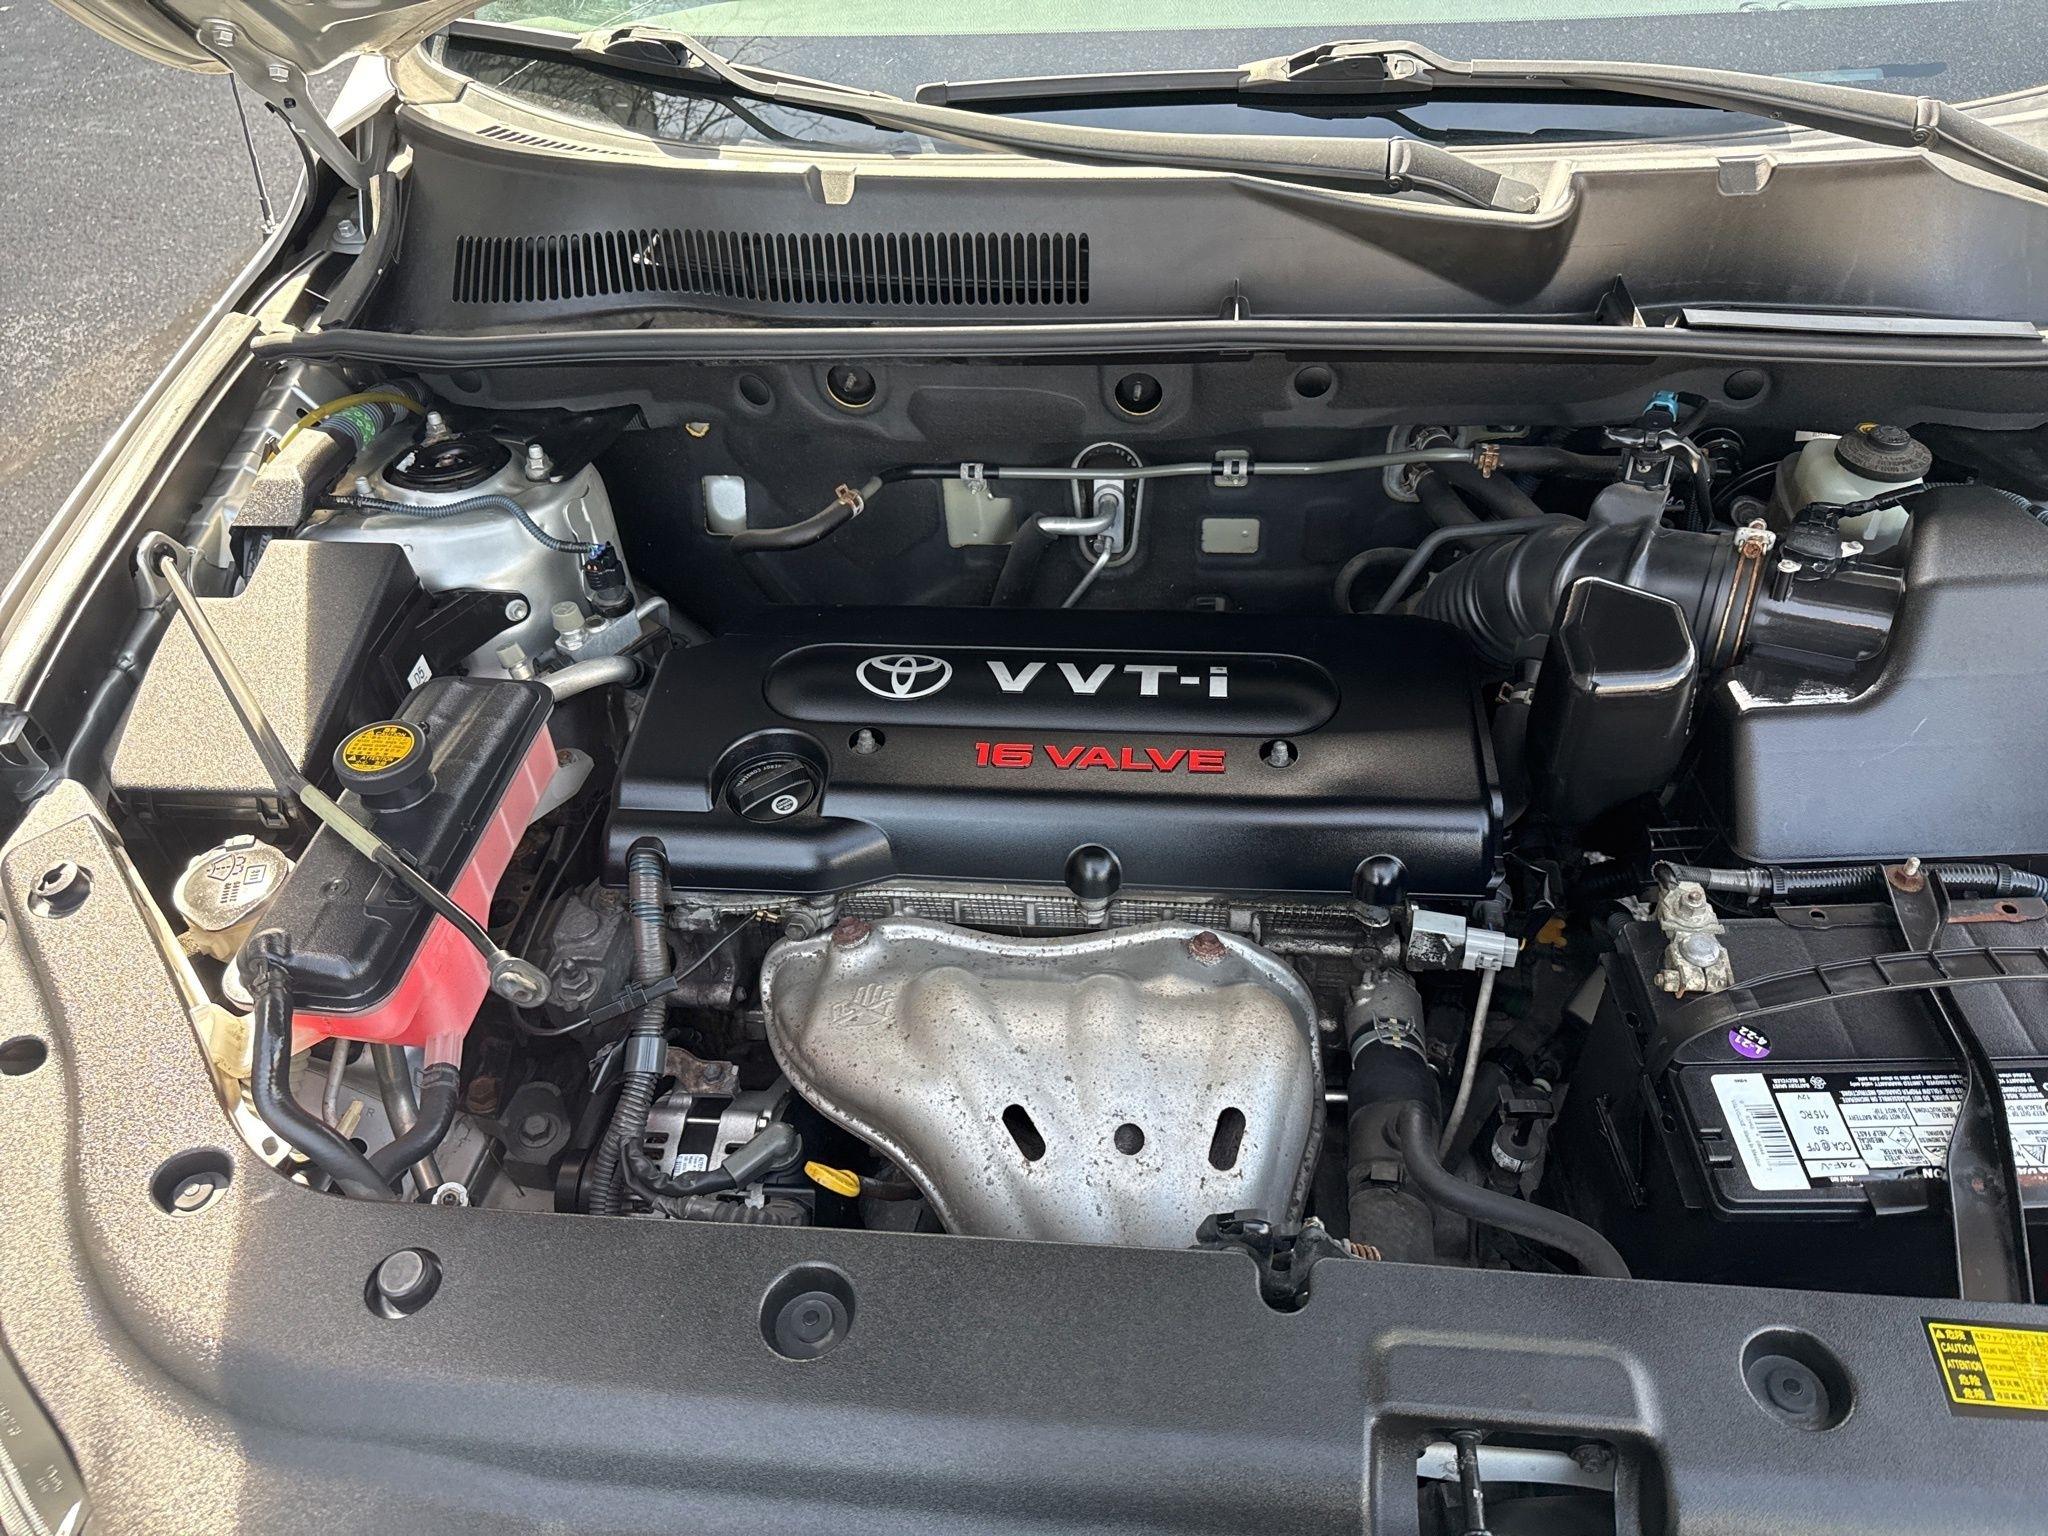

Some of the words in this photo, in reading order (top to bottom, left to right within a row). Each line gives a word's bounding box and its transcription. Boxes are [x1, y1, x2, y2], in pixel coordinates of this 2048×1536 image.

[986, 661, 1228, 697] VVT-i
[975, 742, 1034, 768] 16
[1043, 745, 1226, 774] VALVE
[1799, 1110, 1812, 1119] RC
[1813, 1110, 1829, 1119] 115
[1814, 1125, 1829, 1134] 650
[1831, 1141, 1852, 1150] CCA
[1940, 1342, 1977, 1354] CAUTION
[1947, 1359, 1983, 1371] ATTENTION
